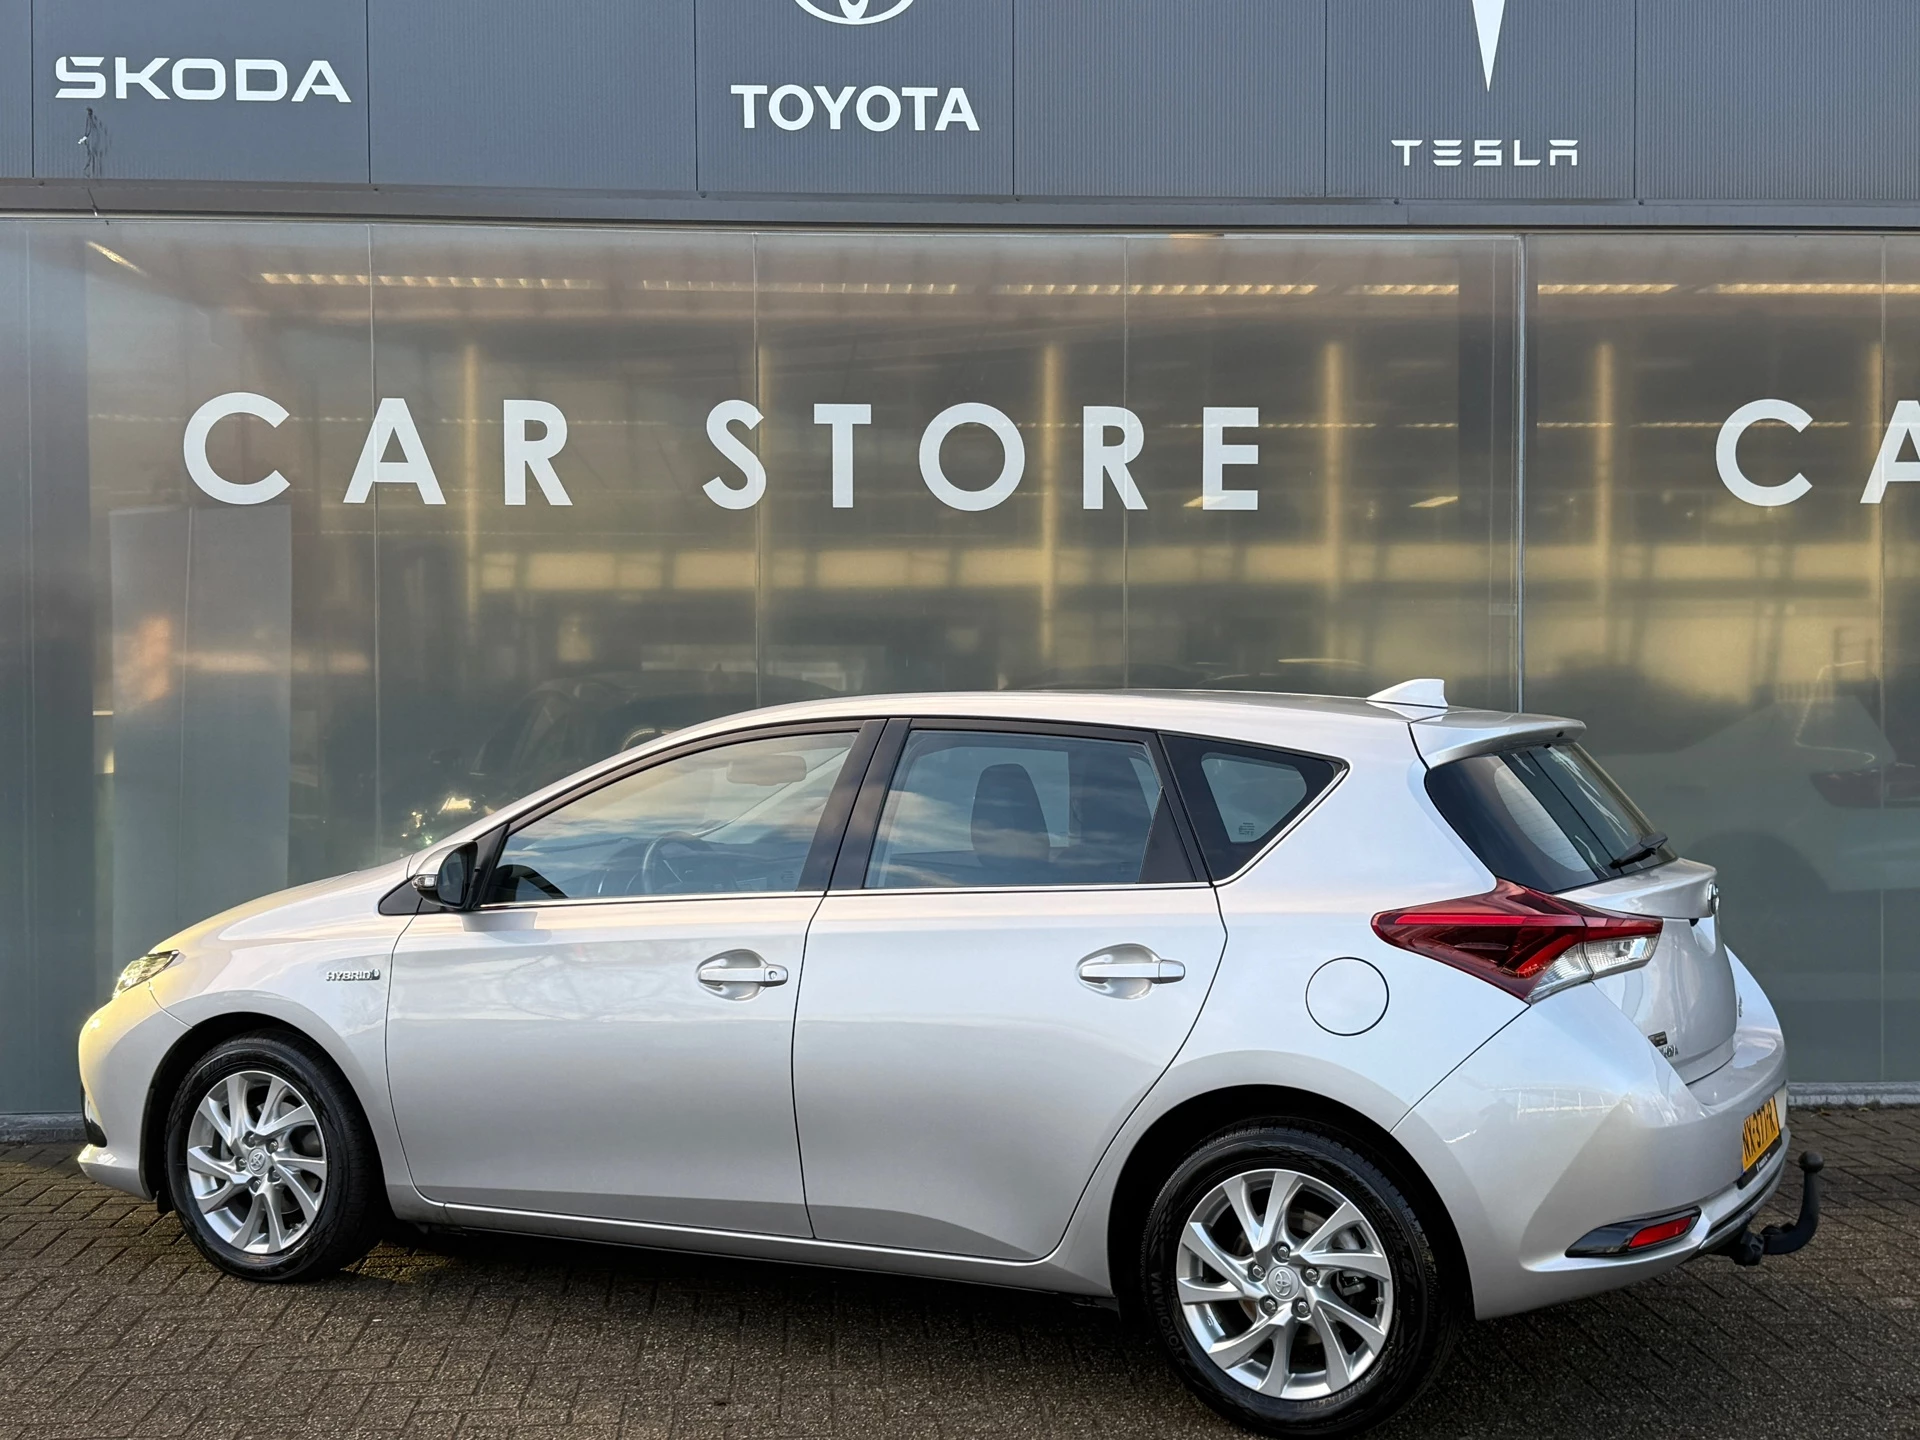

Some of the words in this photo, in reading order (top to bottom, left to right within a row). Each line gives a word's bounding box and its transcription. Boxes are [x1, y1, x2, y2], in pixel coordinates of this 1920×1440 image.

[55, 56, 352, 103] SKODA
[731, 84, 981, 132] TOYOTA
[1392, 139, 1579, 167] TESLA
[183, 392, 573, 506] CAR
[702, 399, 1260, 511] STORE
[326, 970, 372, 982] HYBRID
[1742, 1101, 1776, 1162] NX-377-R
[1150, 1270, 1184, 1356] YOKOHAMA
